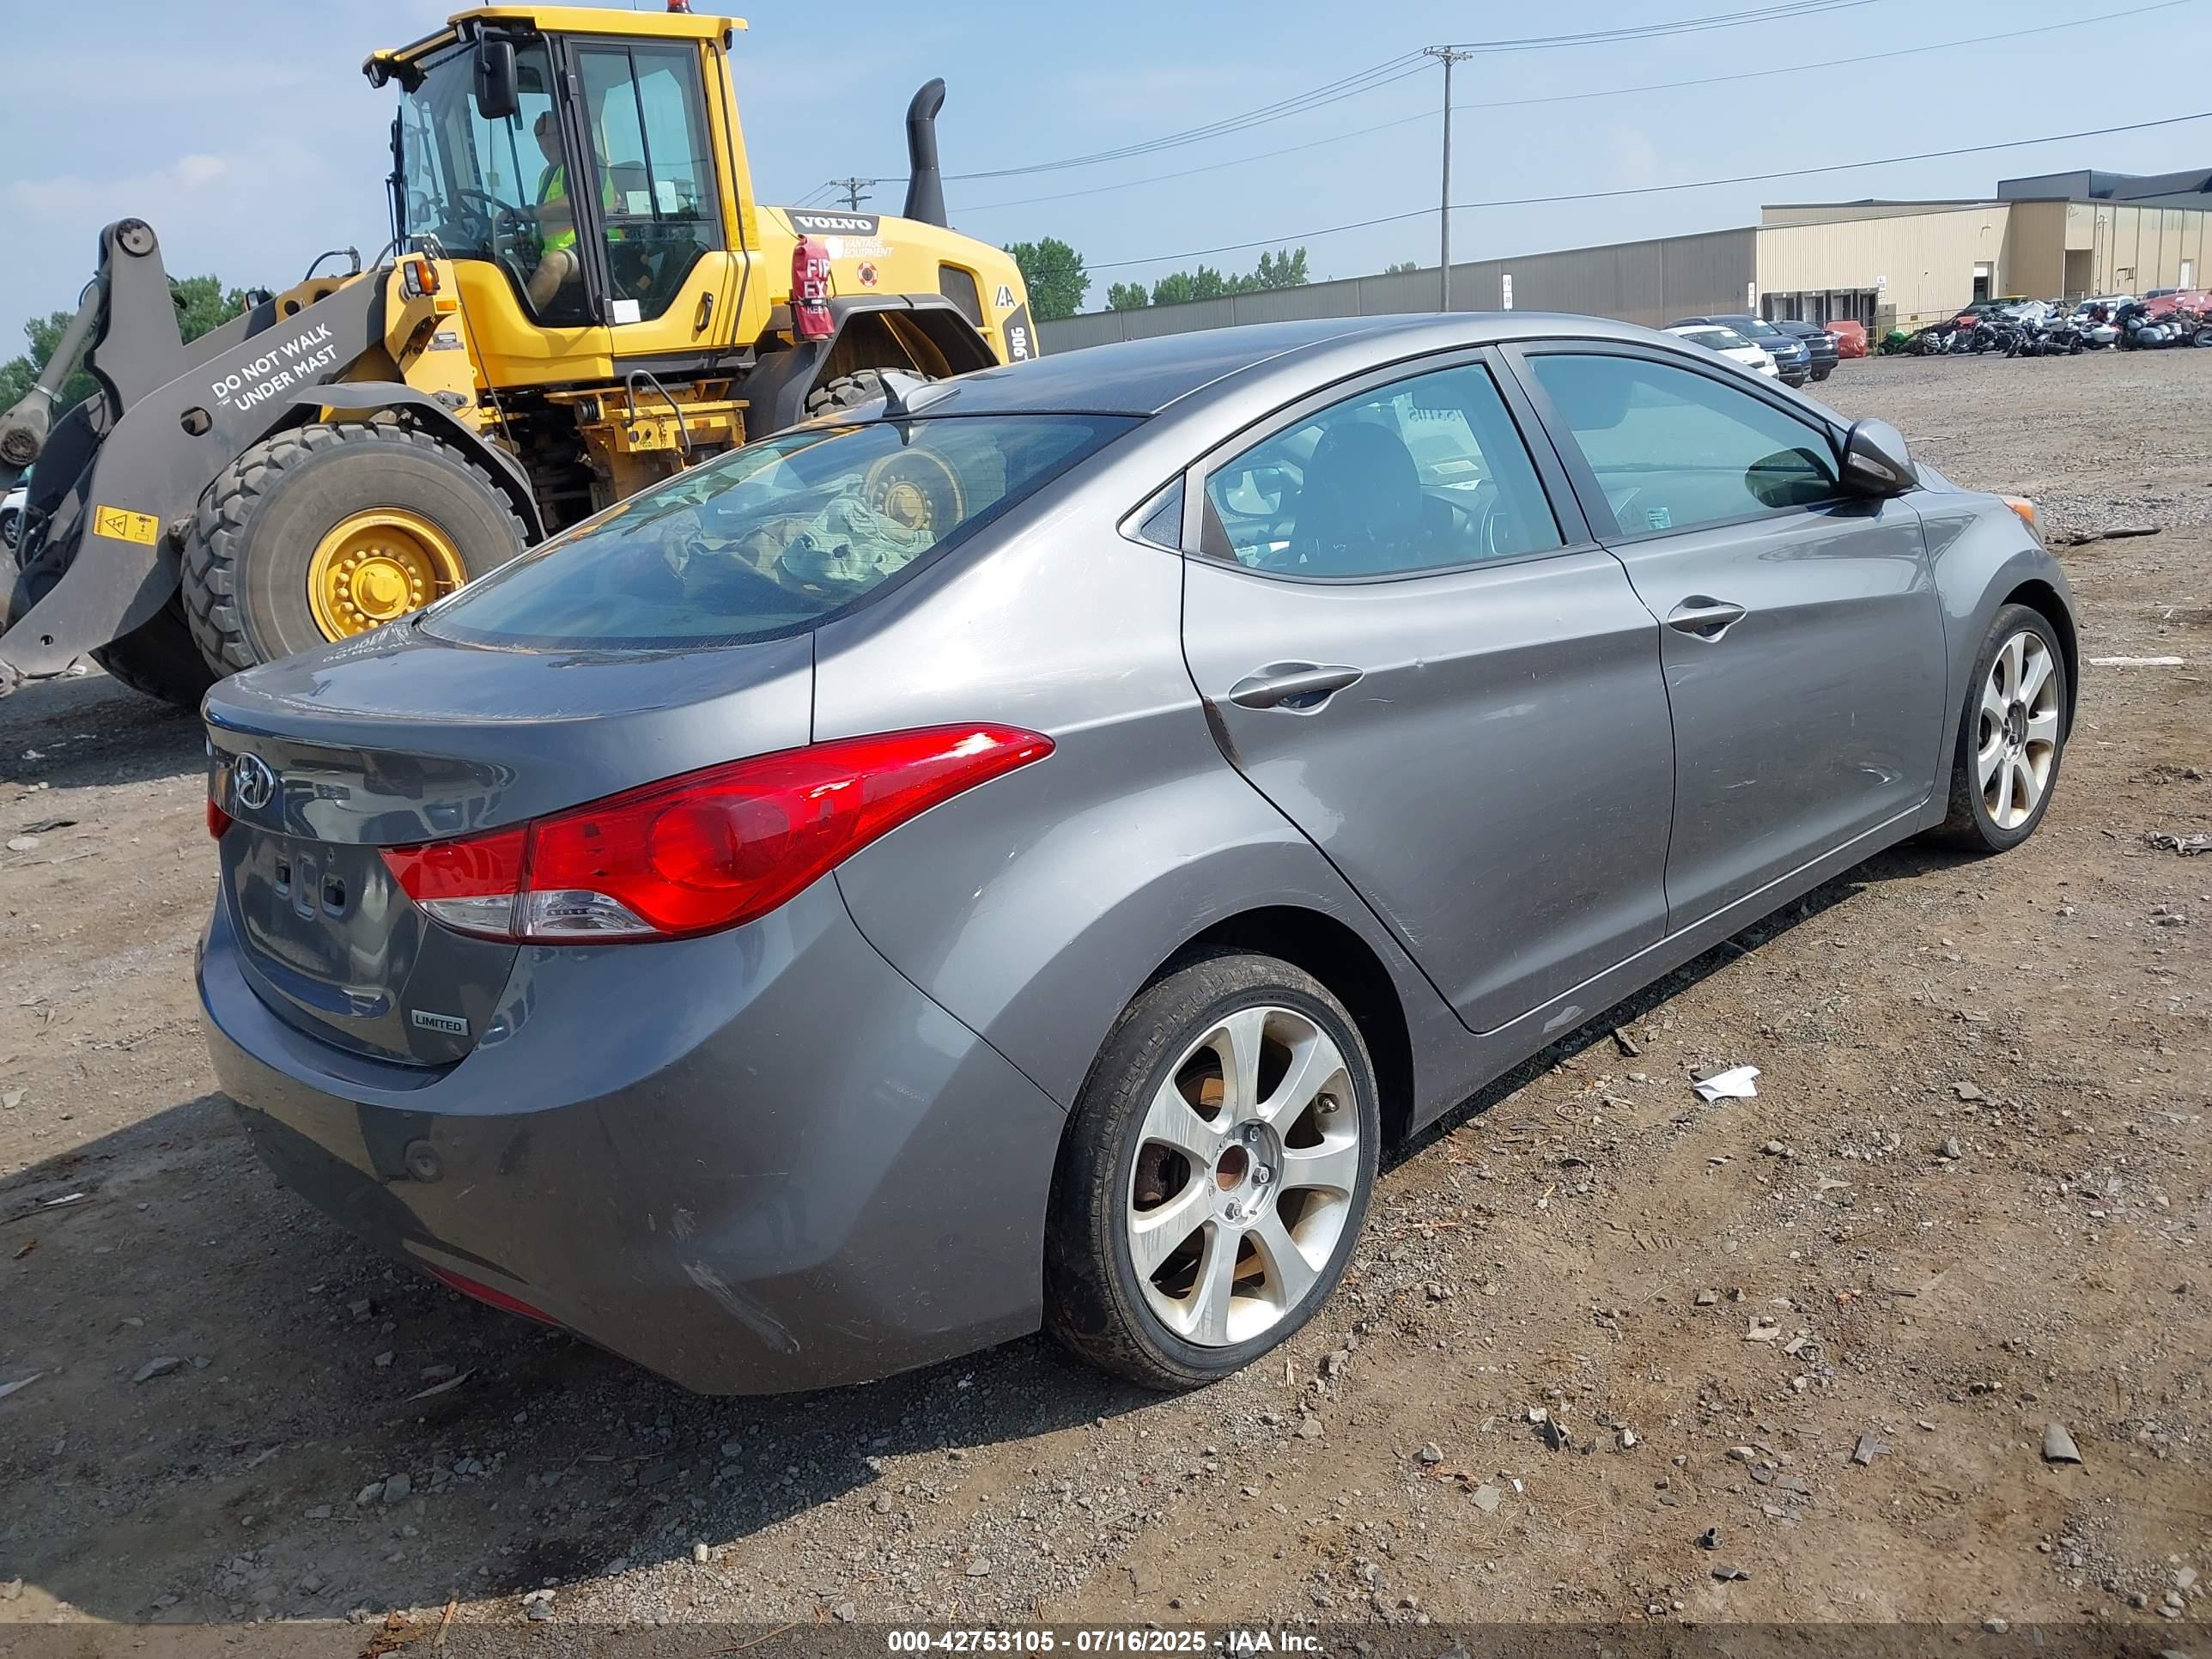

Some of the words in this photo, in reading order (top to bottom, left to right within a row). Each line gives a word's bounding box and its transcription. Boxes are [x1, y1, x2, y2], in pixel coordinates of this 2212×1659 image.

[794, 216, 872, 230] VOLVO
[843, 239, 884, 248] VANTAGE
[843, 246, 894, 258] EQUIPMENT
[804, 281, 827, 299] EX
[211, 374, 241, 398] DO
[241, 350, 281, 381] NOT
[280, 323, 332, 358] WALK
[234, 371, 295, 410] UNDER
[293, 344, 337, 379] MAST
[416, 1015, 462, 1031] LIMITED
